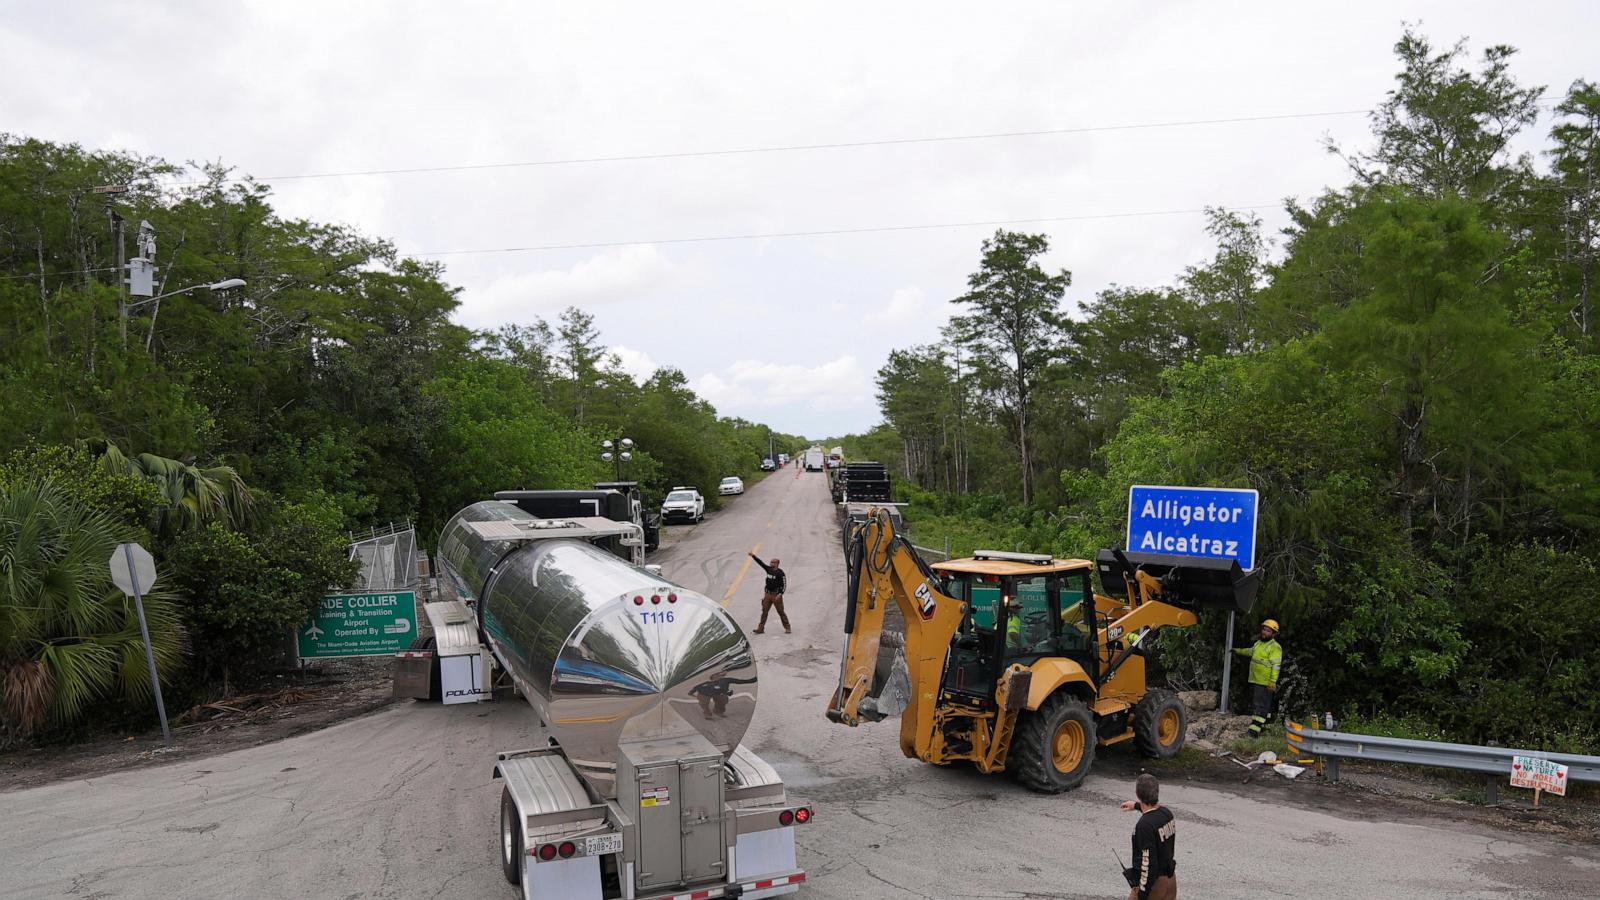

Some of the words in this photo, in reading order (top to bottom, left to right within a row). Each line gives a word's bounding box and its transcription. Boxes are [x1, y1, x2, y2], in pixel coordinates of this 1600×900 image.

[1140, 499, 1243, 527] Alligator
[1140, 530, 1238, 556] Alcatraz
[348, 595, 398, 608] COLLIER
[914, 582, 935, 613] CAT
[358, 608, 392, 616] Transition
[639, 610, 675, 625] T116
[343, 619, 369, 628] Airport
[334, 628, 368, 637] Operated
[369, 627, 379, 636] By
[446, 688, 482, 698] POLAR
[1518, 756, 1561, 771] PRESERVE
[1522, 764, 1554, 776] NATURE
[1511, 777, 1563, 794] DESTRUCTION
